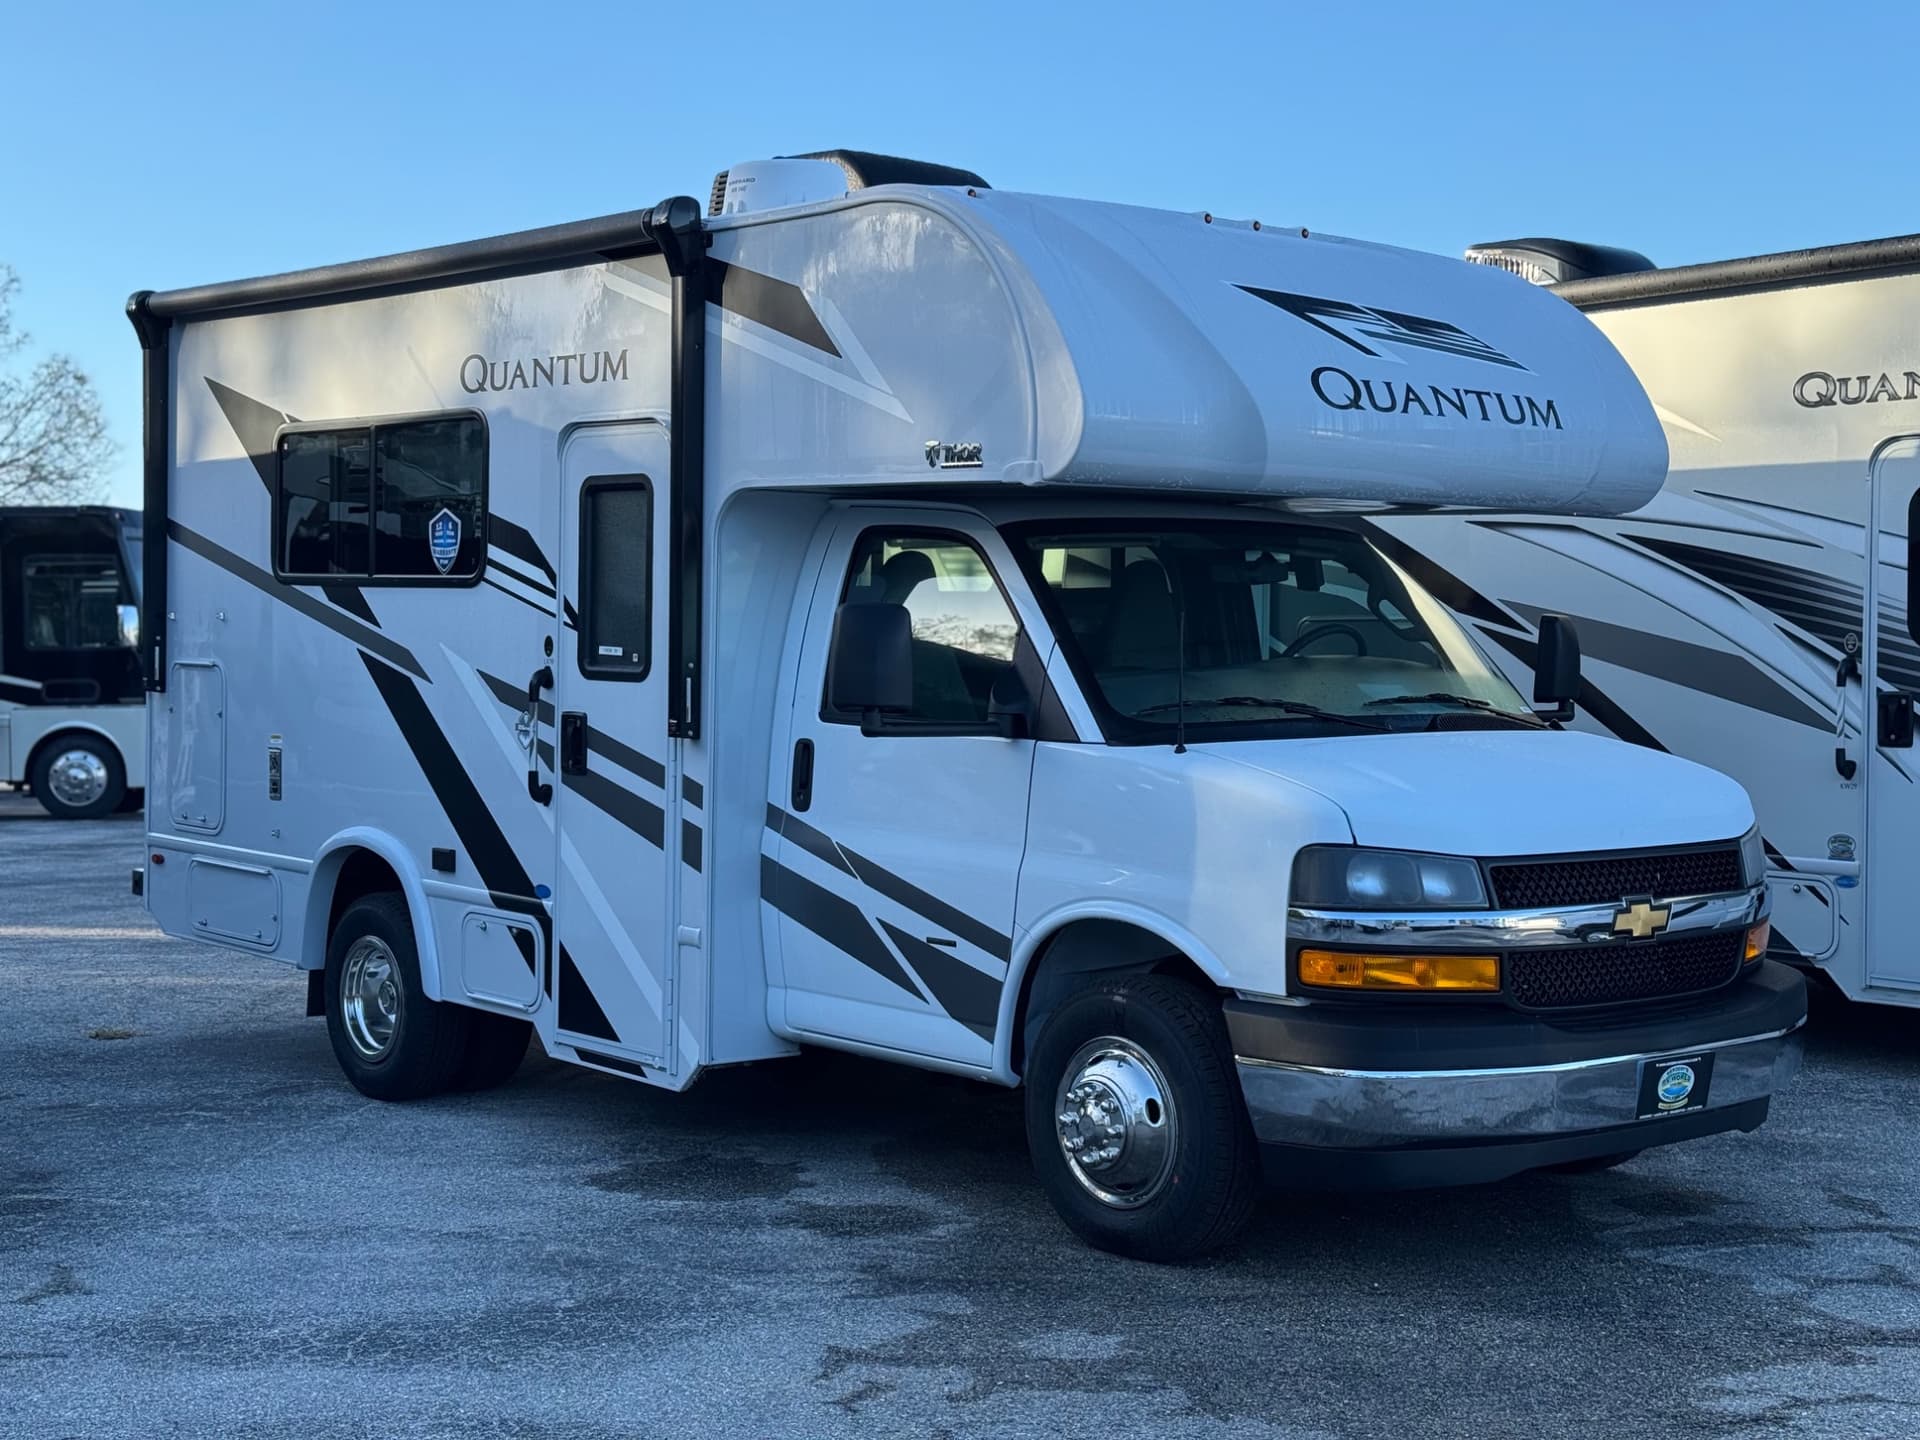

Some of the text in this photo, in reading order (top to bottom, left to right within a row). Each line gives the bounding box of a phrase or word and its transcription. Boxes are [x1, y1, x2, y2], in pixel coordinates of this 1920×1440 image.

[460, 348, 629, 394] QUANTUM
[1310, 366, 1564, 430] QUANTUM
[941, 441, 984, 462] THOR
